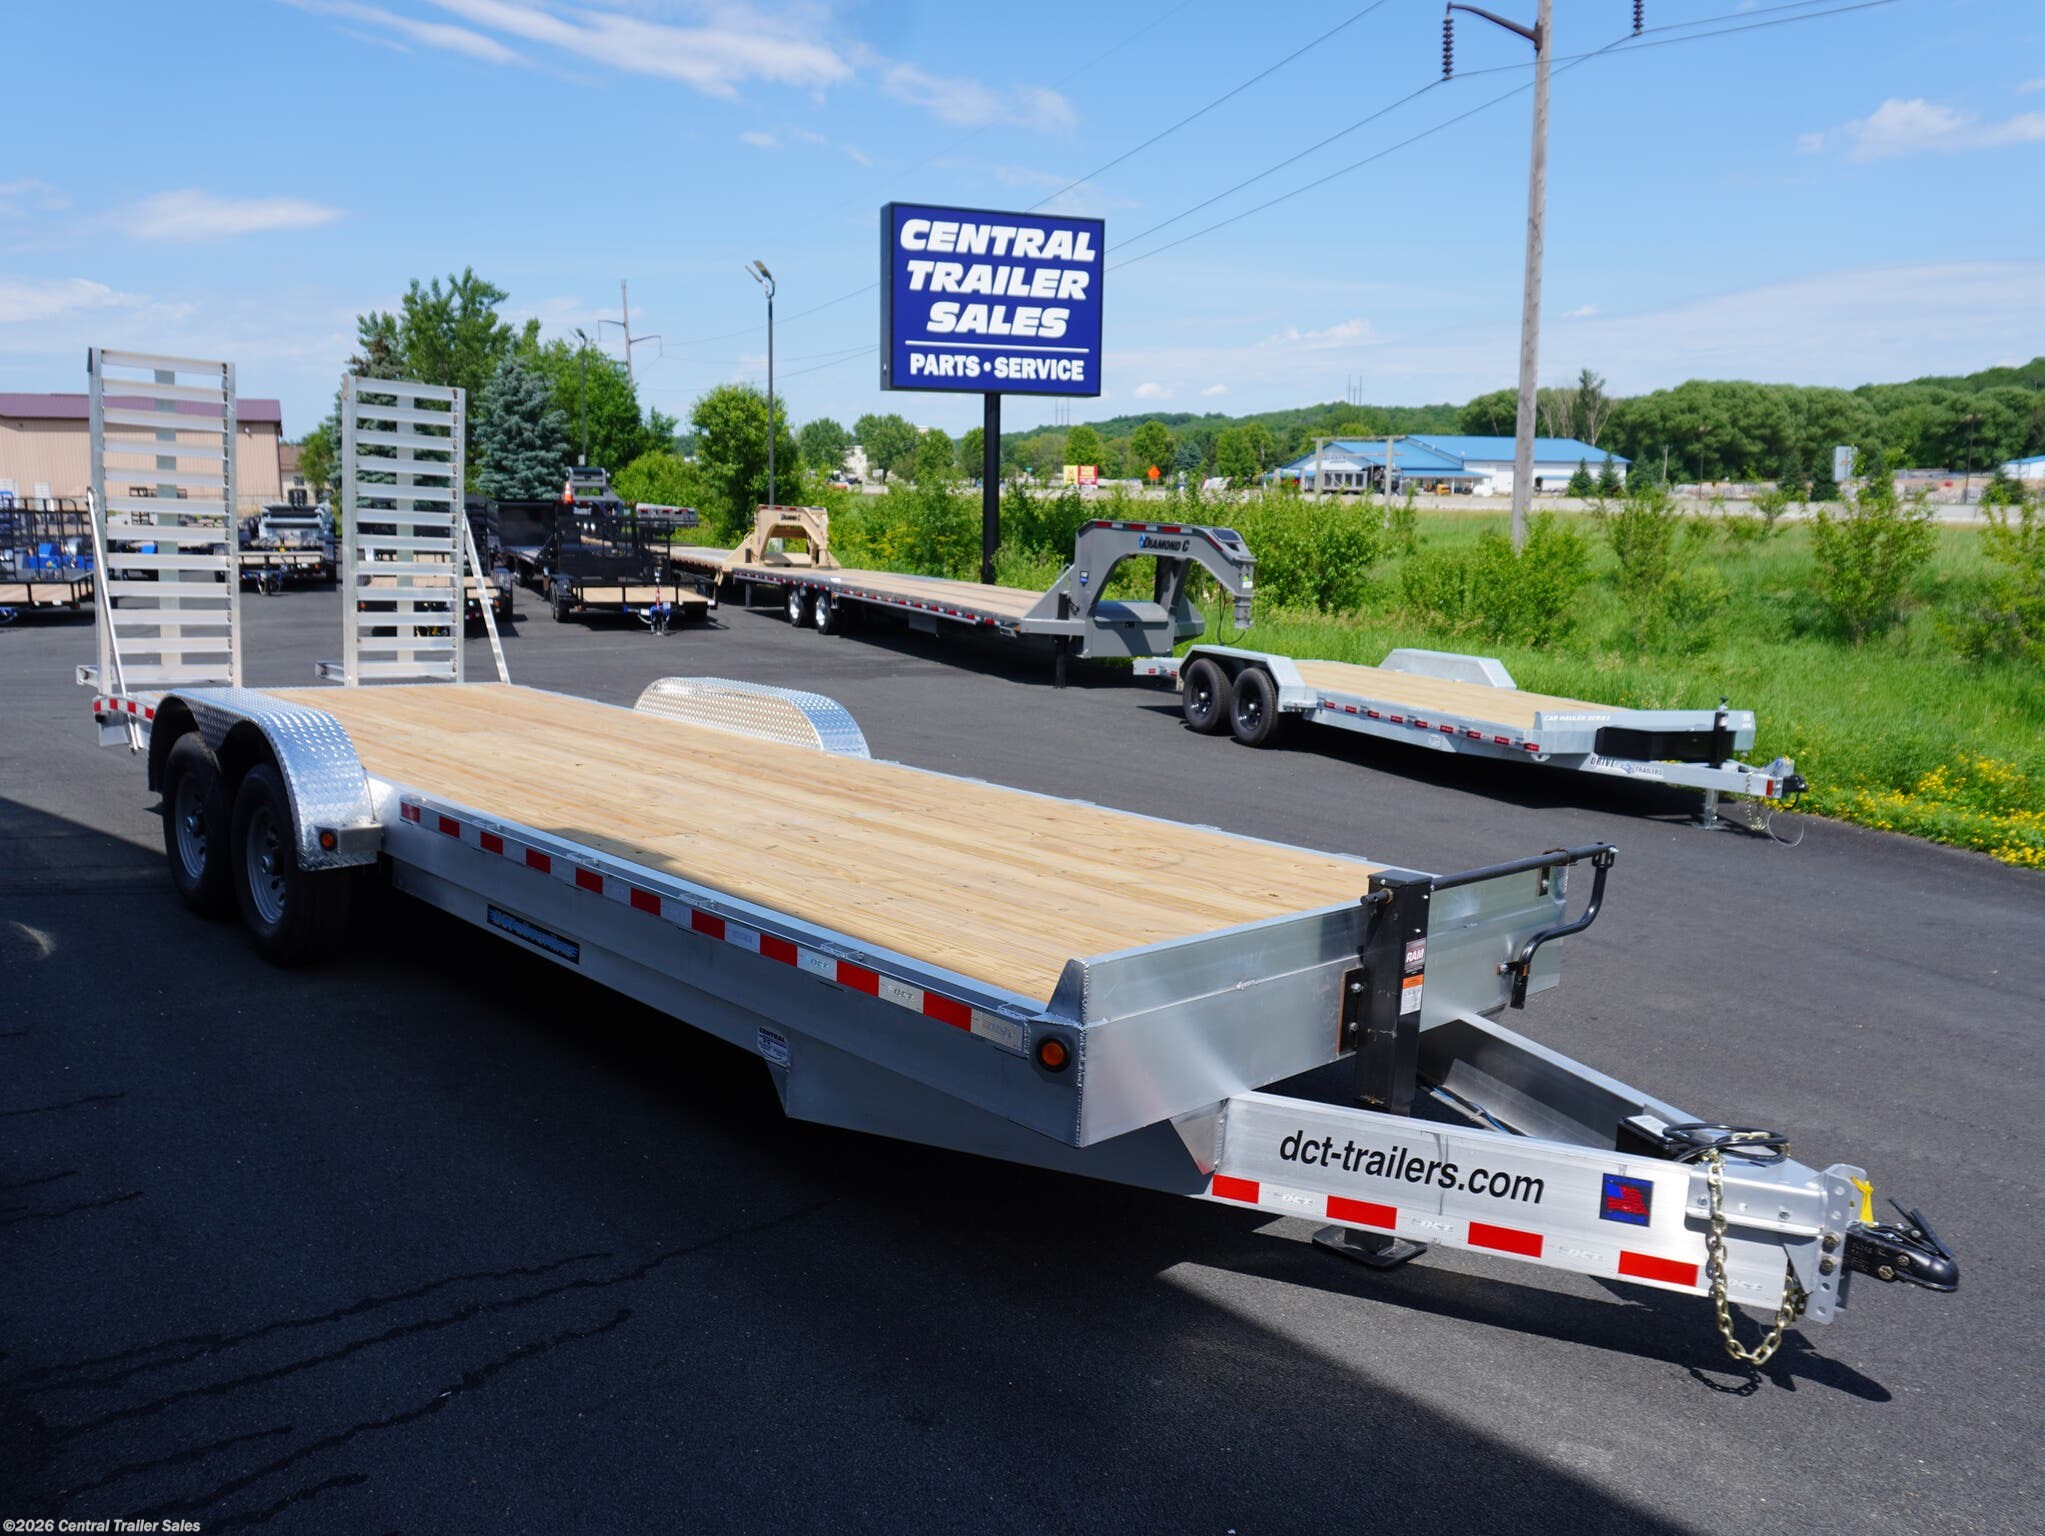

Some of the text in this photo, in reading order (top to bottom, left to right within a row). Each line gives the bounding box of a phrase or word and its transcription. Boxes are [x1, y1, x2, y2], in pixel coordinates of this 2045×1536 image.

[900, 218, 1096, 262] CENTRAL
[906, 259, 1090, 300] TRAILER
[926, 301, 1070, 338] SALES
[910, 353, 1085, 382] PARTS SERVICE
[1182, 540, 1190, 552] C
[1590, 756, 1662, 775] DRIVE TRAILERS
[1406, 948, 1425, 963] RAM
[1279, 1130, 1544, 1204] dct-trailers.com
